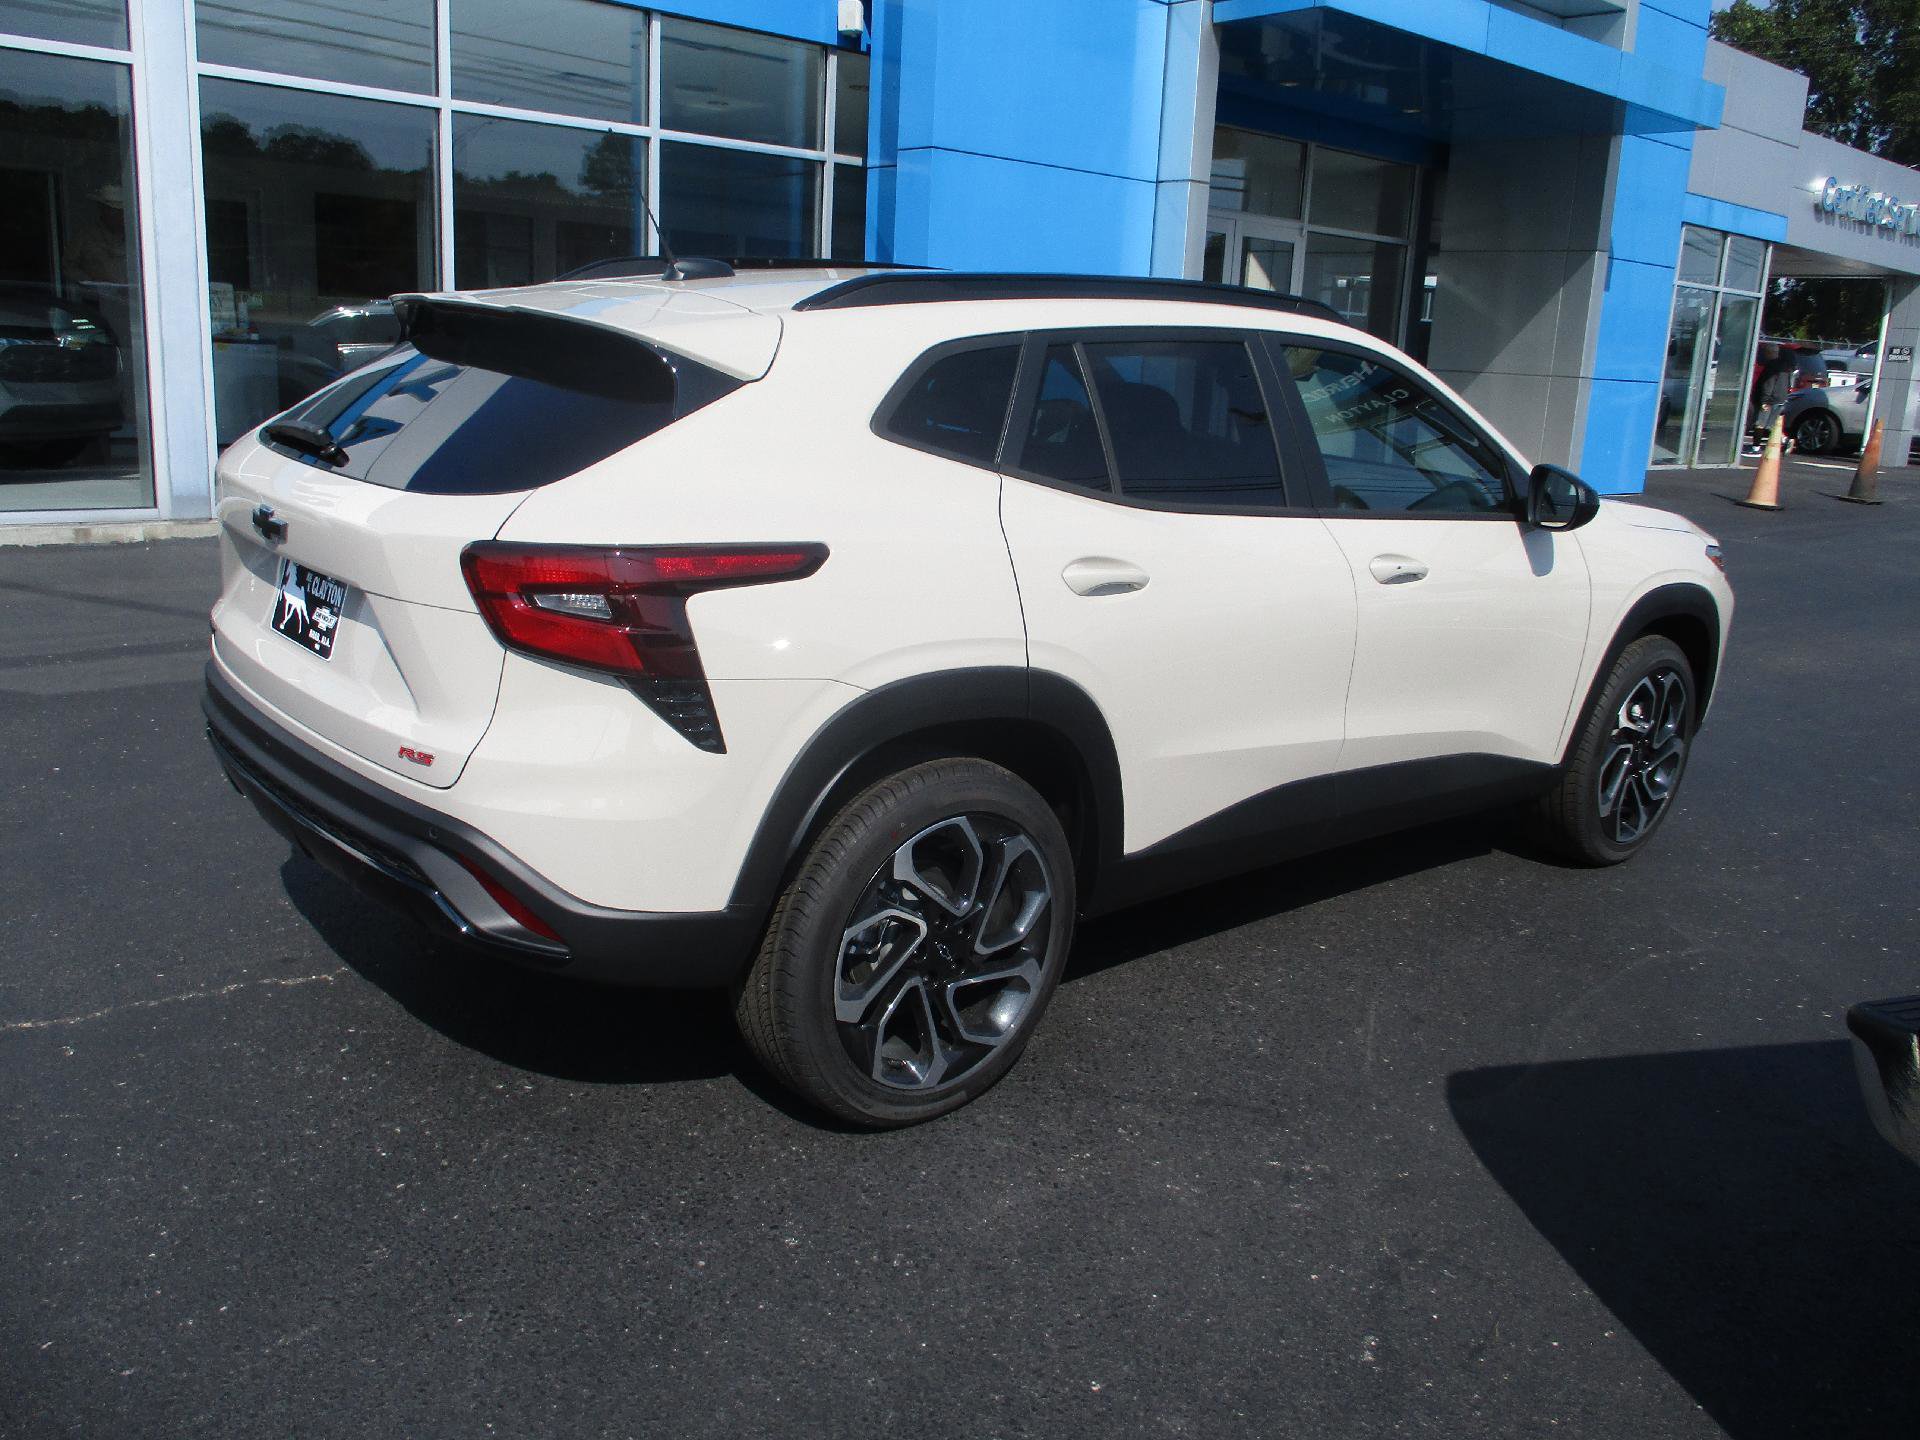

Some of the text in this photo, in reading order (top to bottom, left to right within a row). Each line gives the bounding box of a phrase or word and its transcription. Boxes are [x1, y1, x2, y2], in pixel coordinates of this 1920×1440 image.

[1822, 176, 1885, 225] Certified
[311, 575, 344, 607] CLAYTON
[398, 745, 434, 767] RS
